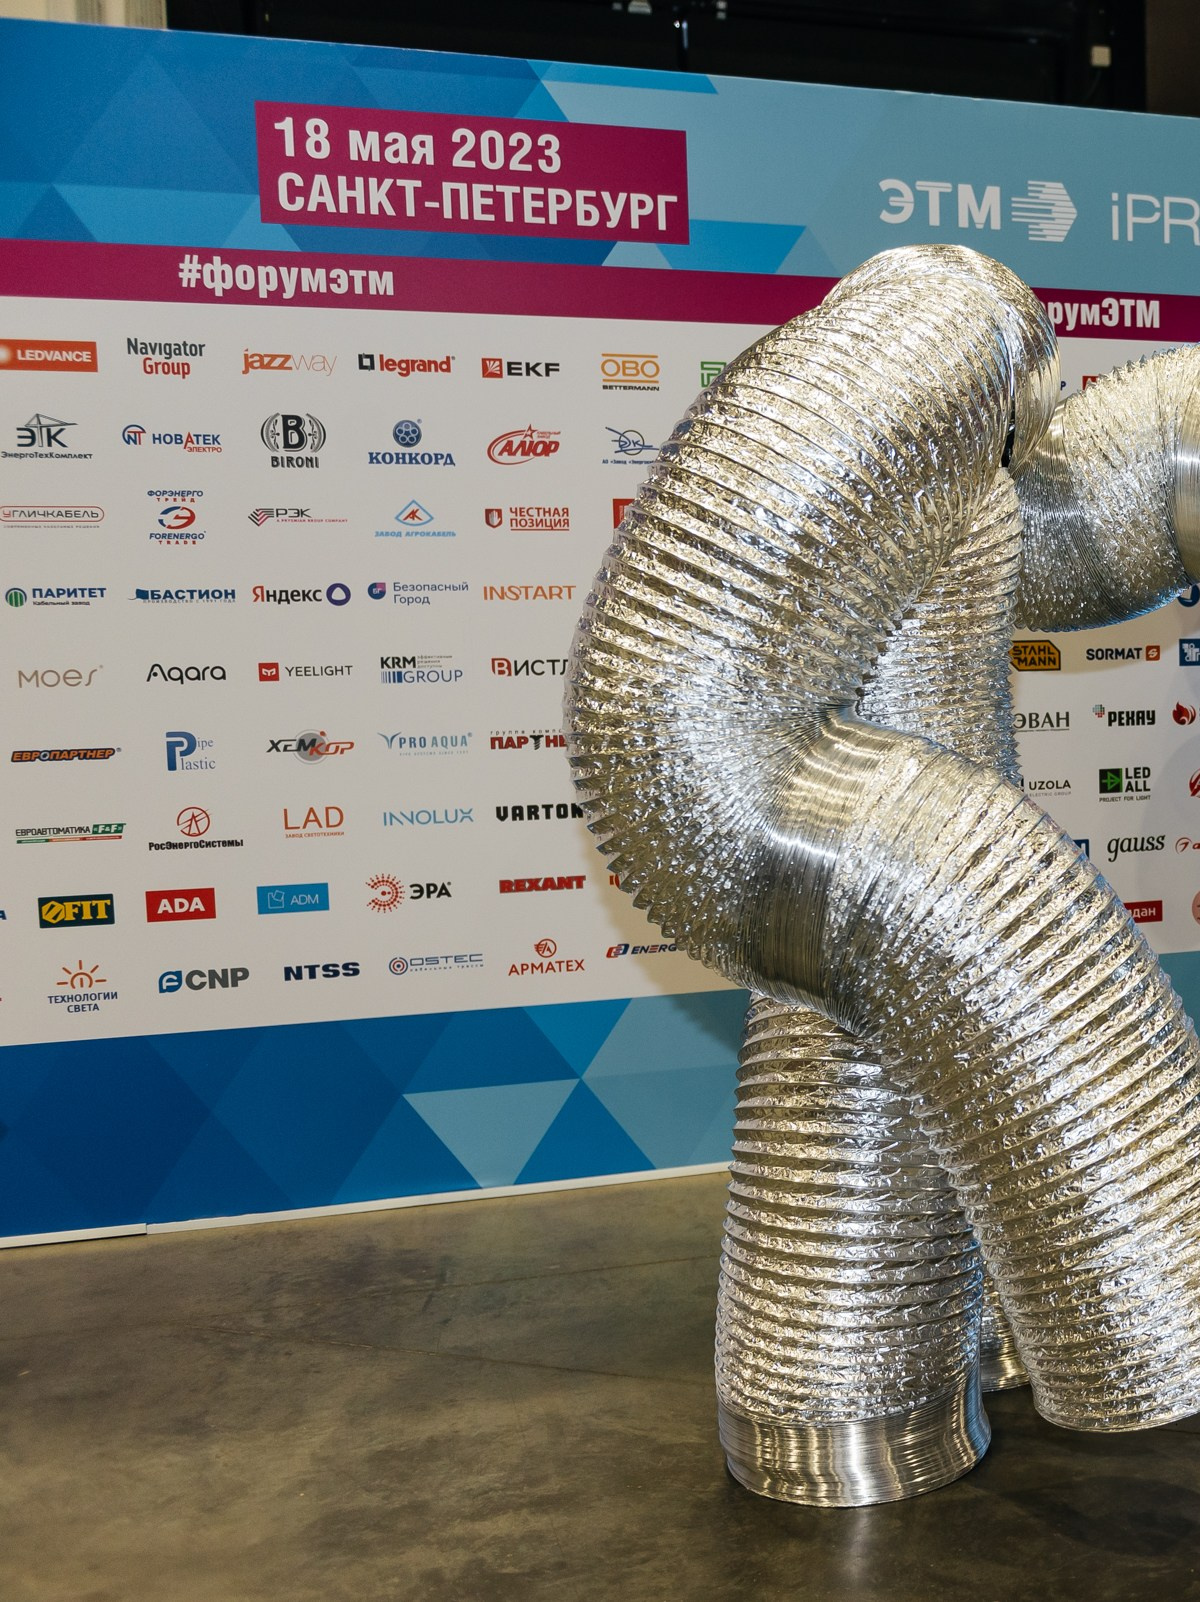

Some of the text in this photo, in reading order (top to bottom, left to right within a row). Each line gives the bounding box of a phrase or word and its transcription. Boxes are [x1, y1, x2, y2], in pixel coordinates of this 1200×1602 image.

[274, 117, 562, 173] 18 мая 2023
[277, 172, 678, 231] САНКТ-ПЕТЕРБУРГ
[879, 178, 1001, 231] ЭТМ
[178, 255, 394, 298] #форумэтм
[1040, 297, 1160, 331] румЭТМ
[127, 337, 206, 360] Navigator
[17, 349, 92, 363] LEDVANCE
[241, 348, 338, 377] jazzway
[143, 357, 191, 379] Group
[506, 361, 560, 377] EKF
[601, 359, 660, 379] OBO
[602, 384, 660, 392] BETTERMANN
[152, 432, 222, 451] НОВАТЕК
[498, 440, 560, 458] АЛЮР
[271, 456, 319, 468] BIRONI
[368, 451, 456, 467] КОНКОРД
[147, 490, 203, 498] ФОРЭНЕРГО
[2, 510, 99, 519] УГЛИЧКАБЕЛЬ
[276, 508, 312, 518] РЭК
[509, 507, 570, 518] ЧЕСТНАЯ
[510, 518, 570, 529] ПОЗИЦИЯ
[32, 587, 107, 599] ПАРИТЕТ
[393, 582, 469, 592] Безопасный
[483, 585, 577, 601] INSTART
[150, 589, 236, 600] БАСТИОН
[251, 585, 323, 605] Яндекс
[393, 594, 431, 606] Город
[1012, 645, 1055, 656] STAHL
[1086, 647, 1143, 661] SORMAT
[380, 656, 416, 669] KRM
[1013, 656, 1057, 666] MANN
[146, 663, 227, 684] Aqara
[285, 665, 353, 677] YEELIGHT
[403, 669, 463, 683] GROUP
[1013, 711, 1070, 729] ЭВАН
[399, 736, 427, 749] PRO
[11, 748, 115, 763] ЕВРОПАРТНЕР
[1125, 766, 1151, 779] LED
[1029, 780, 1071, 791] UZOLA
[1125, 780, 1151, 792] ALL
[283, 806, 344, 830] LAD
[496, 803, 584, 822] VARTON
[16, 826, 91, 836] ЕВРОАВТОМАТИКА
[148, 838, 244, 851] РосЭнергоСистемы
[1107, 834, 1166, 863] gauss
[409, 882, 452, 899] ЭРА
[499, 875, 586, 893] REXANT
[157, 897, 205, 914] ADA
[290, 894, 319, 906] ADM
[63, 899, 111, 921] FIT
[410, 954, 483, 966] OSTEC
[284, 962, 360, 981] NTSS
[185, 967, 249, 991] CNP
[48, 991, 118, 1004] ТЕХНОЛОГИИ
[67, 1004, 100, 1014] СВЕТА
